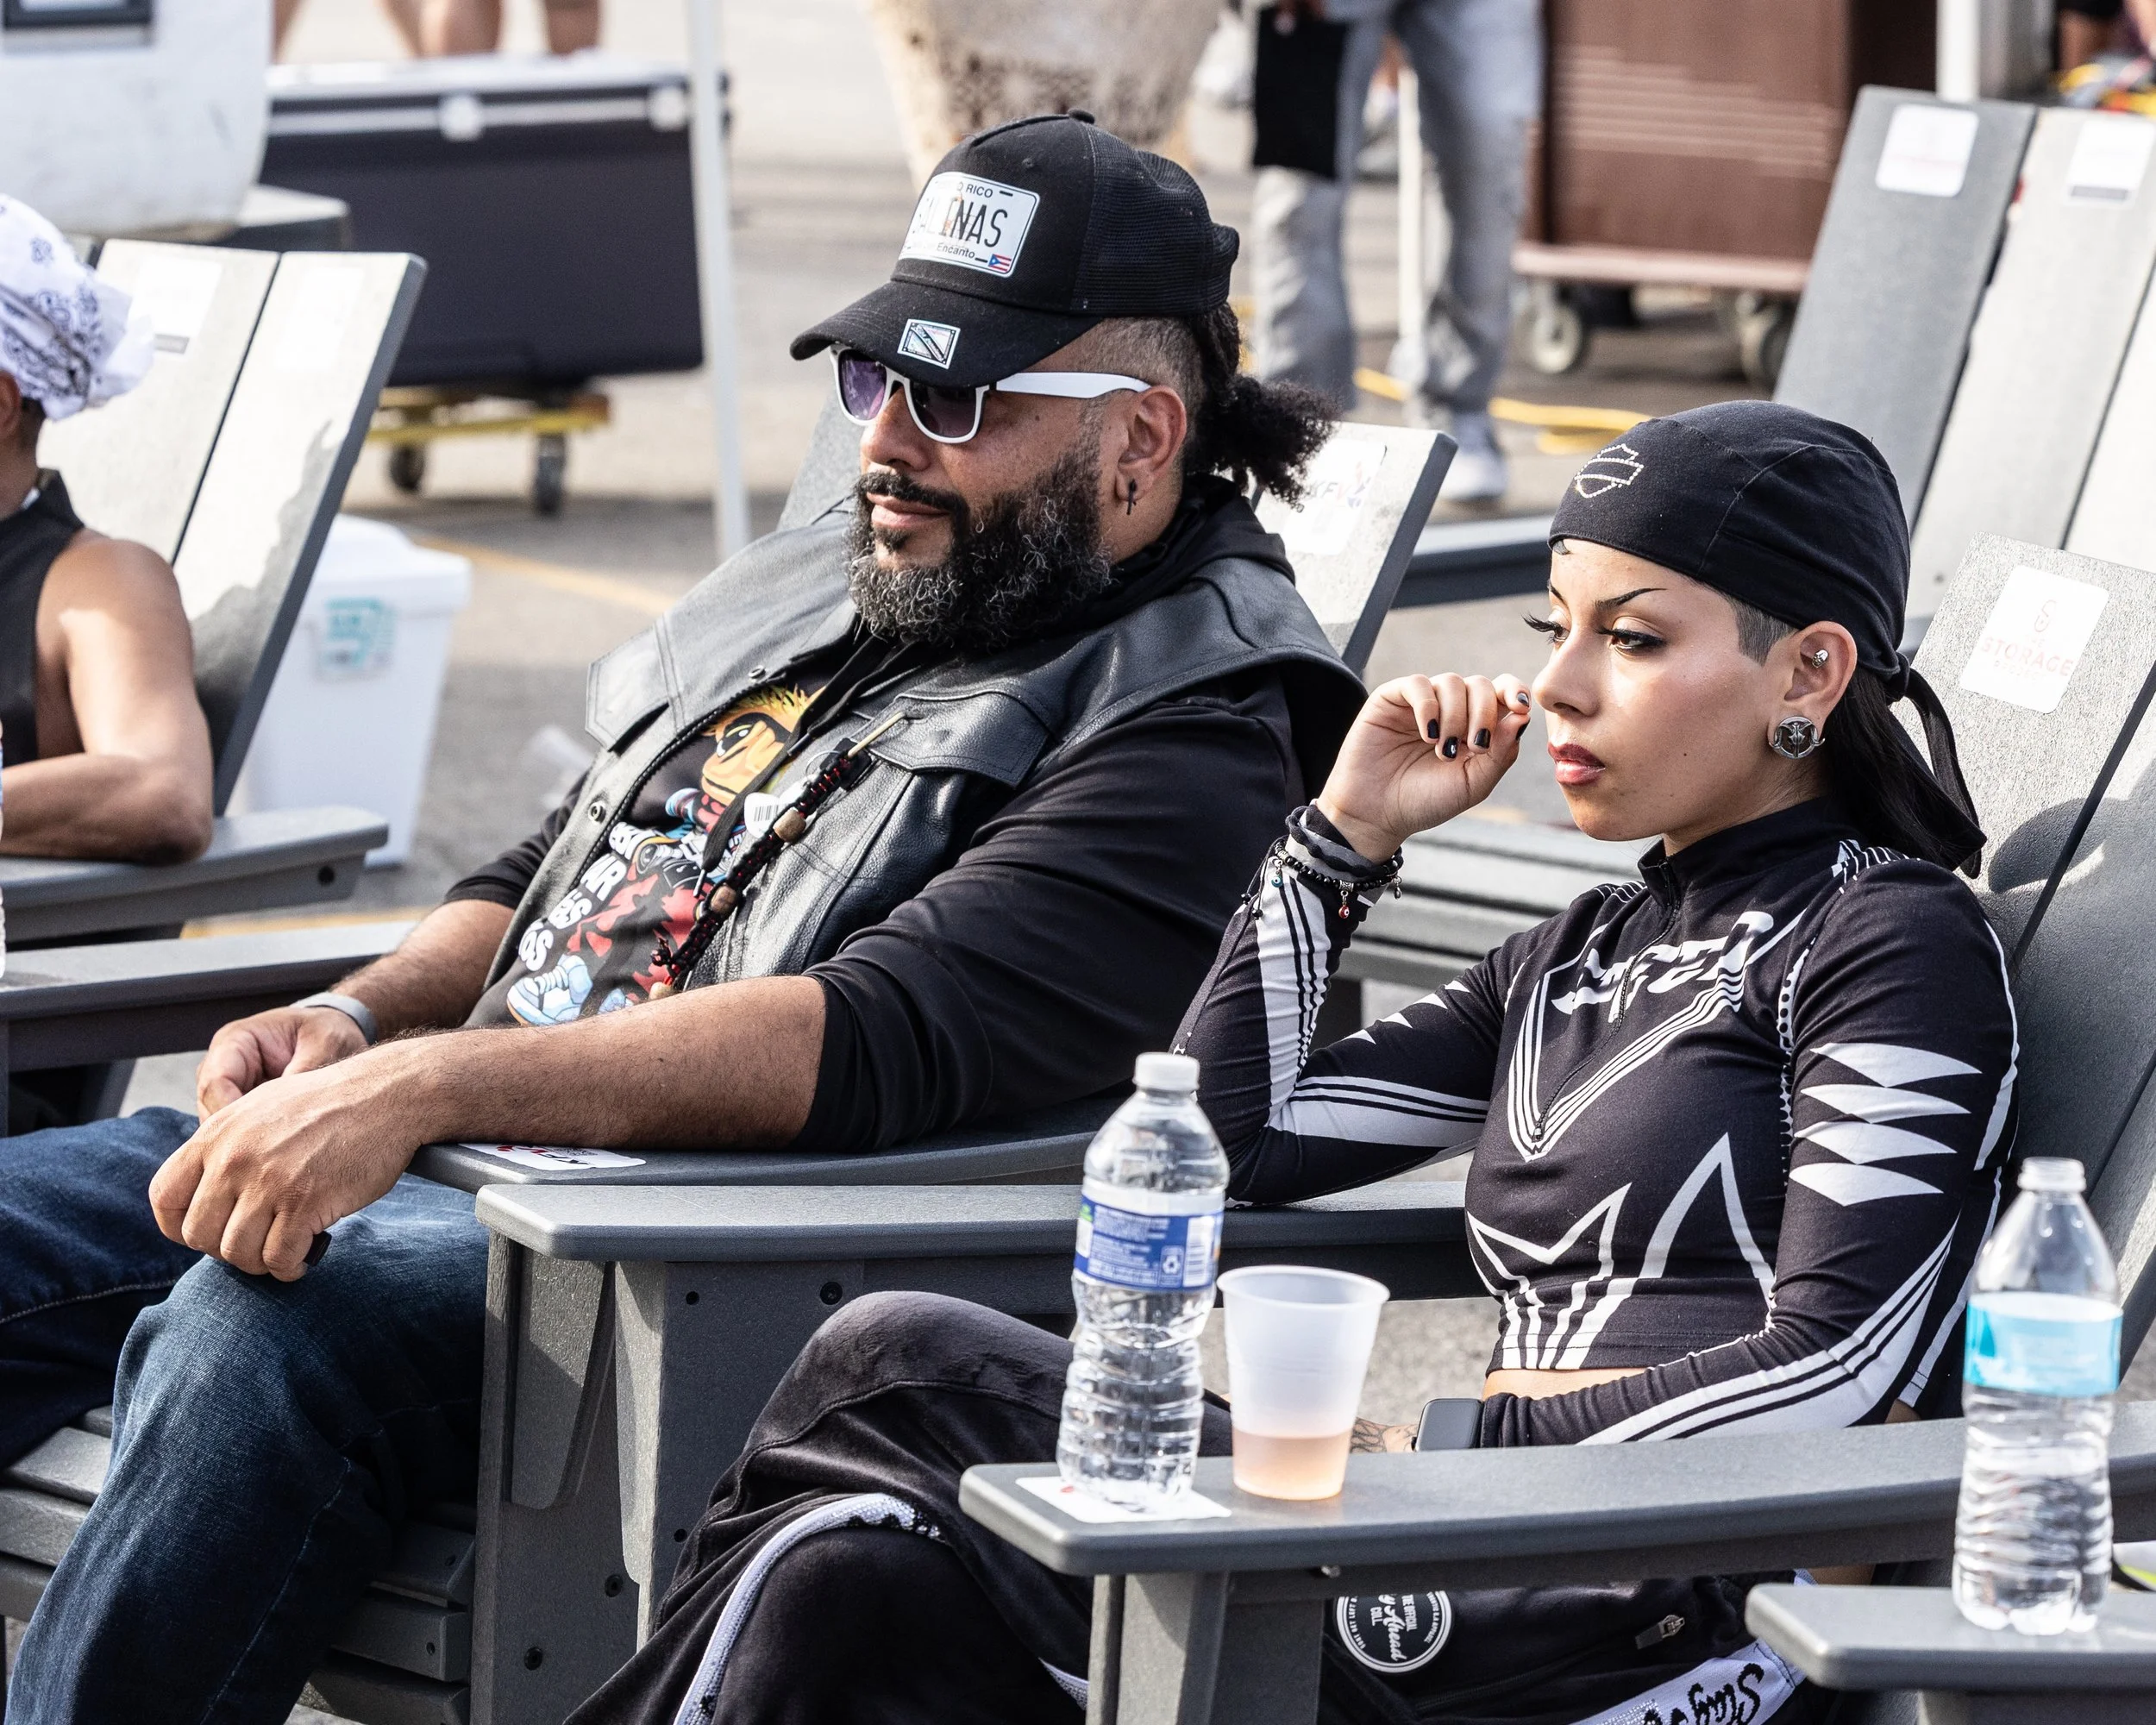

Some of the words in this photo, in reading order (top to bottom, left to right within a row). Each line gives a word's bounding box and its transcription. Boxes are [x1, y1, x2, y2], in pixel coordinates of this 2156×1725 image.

[966, 183, 993, 198] RICO
[937, 242, 975, 259] Encanto
[1403, 1605, 1418, 1632] OFFICIAL
[1382, 1605, 1407, 1662] Ahead
